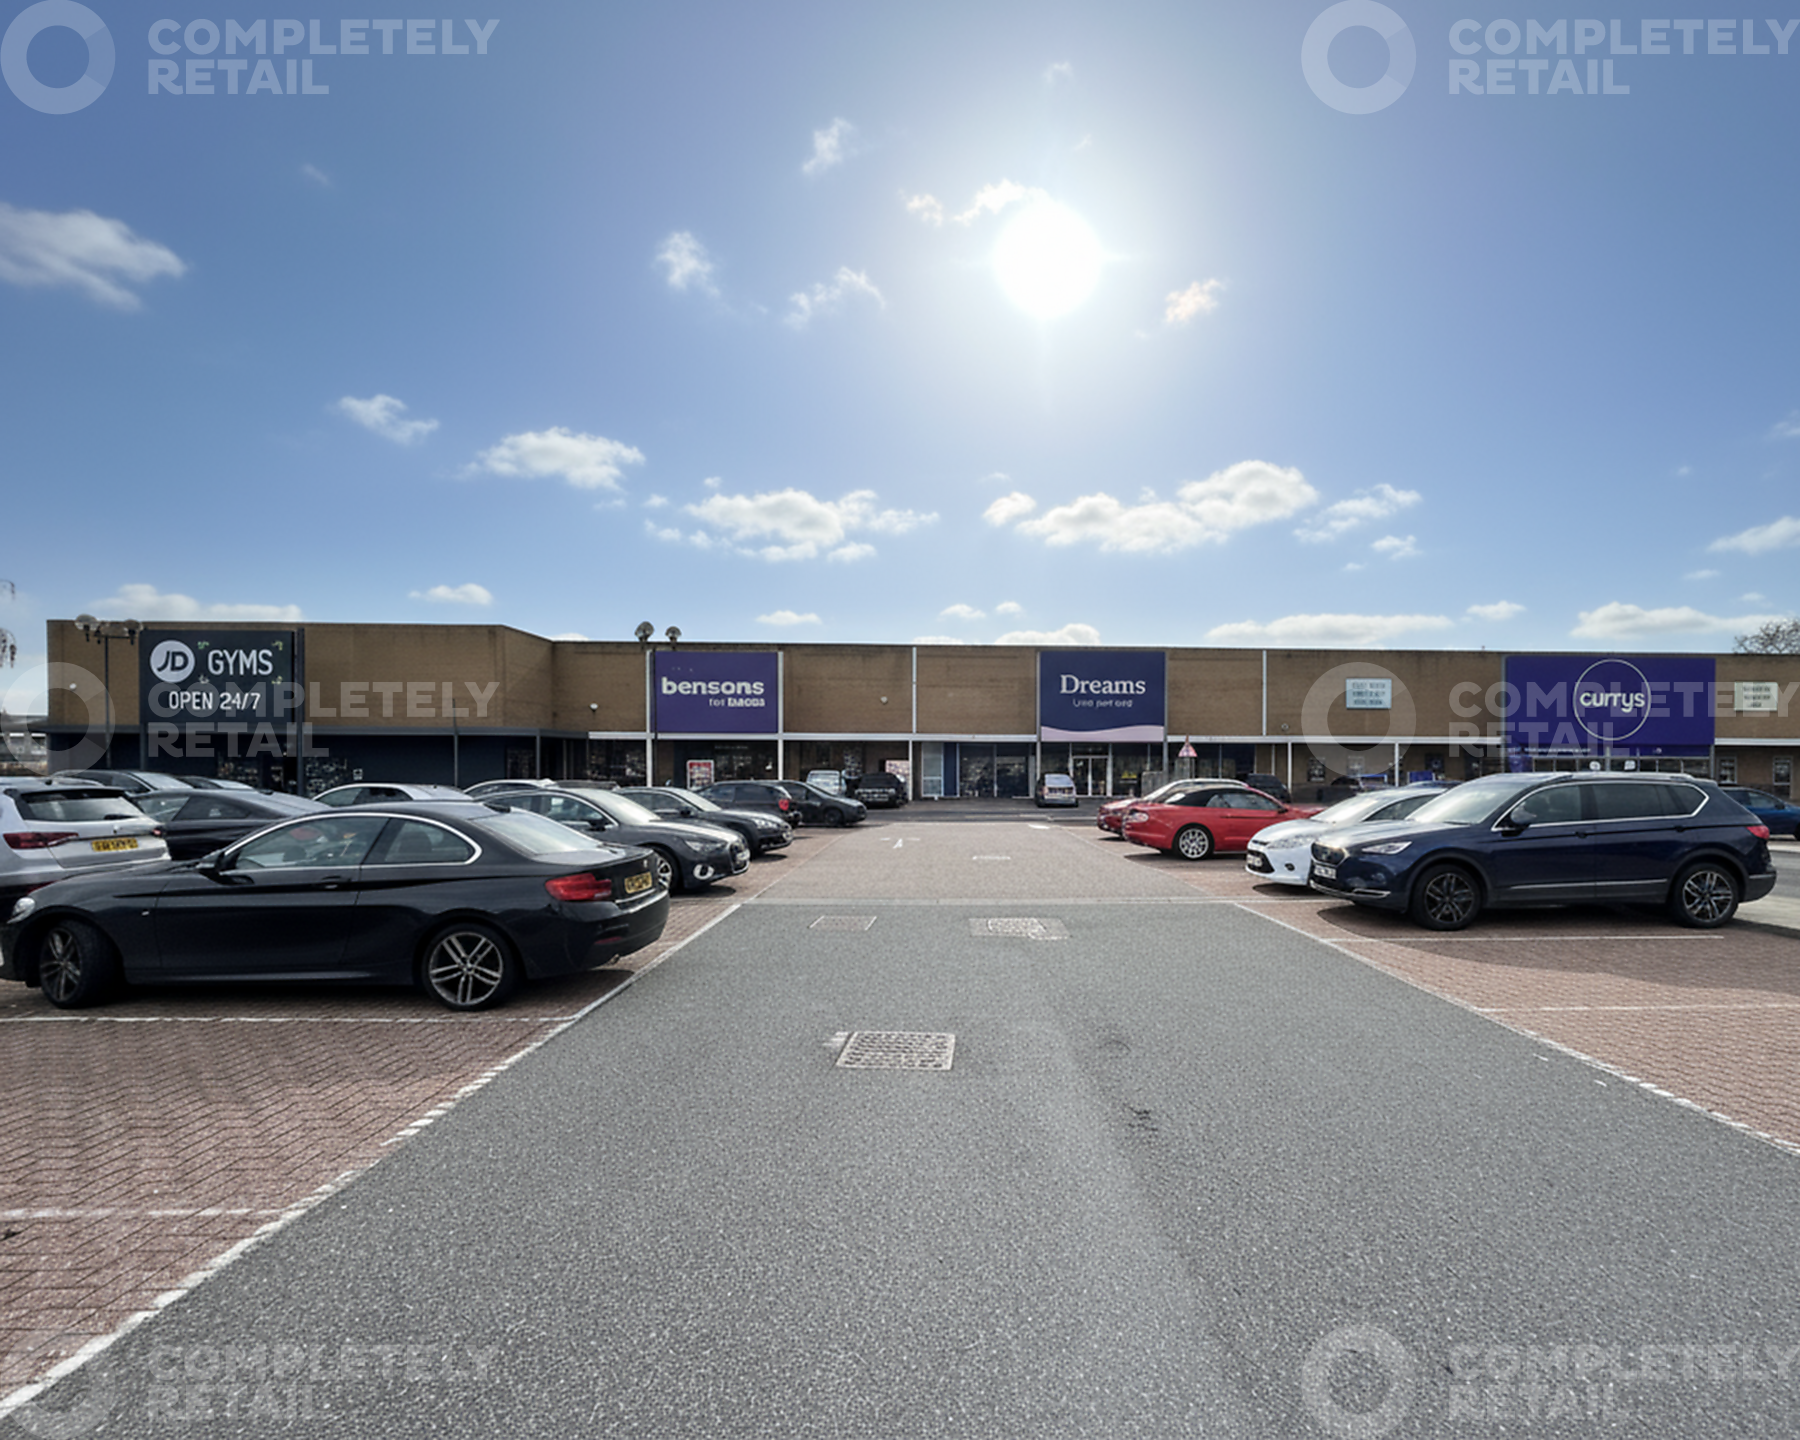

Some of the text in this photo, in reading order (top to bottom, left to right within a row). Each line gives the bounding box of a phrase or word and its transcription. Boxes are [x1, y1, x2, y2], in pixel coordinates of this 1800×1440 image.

[156, 649, 273, 676] JD GYMS
[661, 676, 765, 695] bensons
[1060, 674, 1146, 695] Dreams
[168, 691, 261, 710] OPEN 24/7
[1579, 692, 1645, 713] currys
